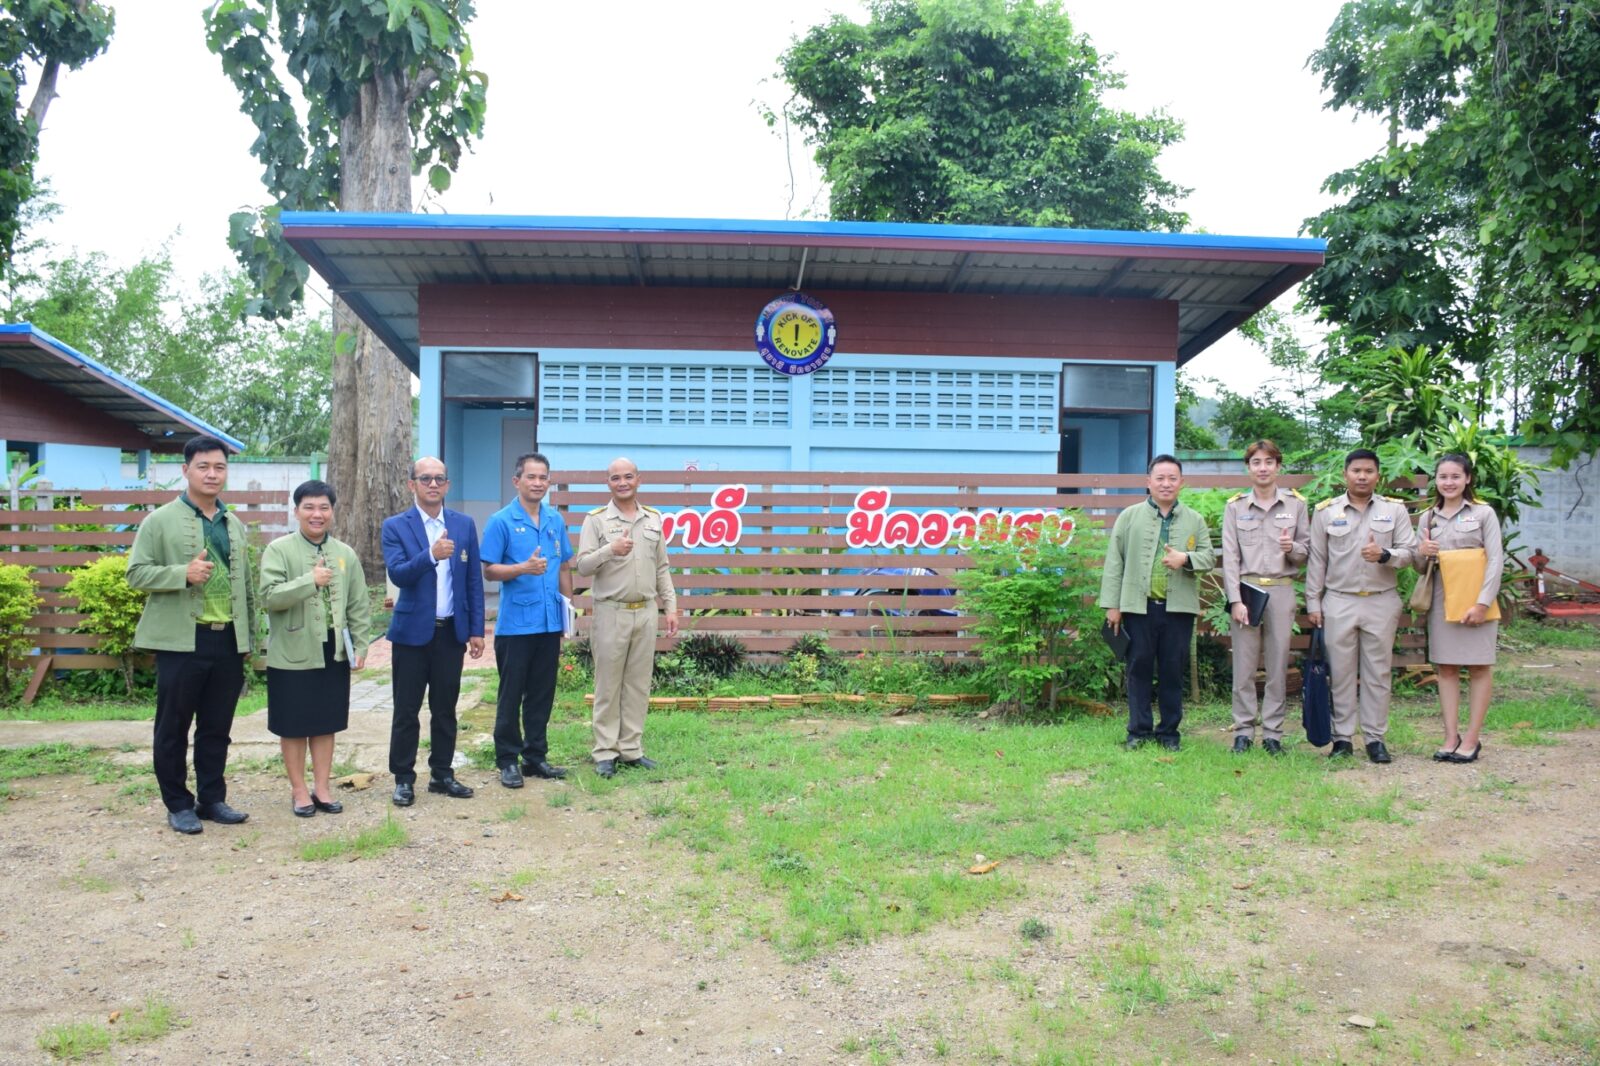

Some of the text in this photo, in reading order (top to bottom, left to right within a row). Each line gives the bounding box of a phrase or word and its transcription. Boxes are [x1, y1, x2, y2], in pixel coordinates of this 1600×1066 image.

[778, 312, 817, 329] KICK OFF
[774, 337, 818, 357] RENOVATE
